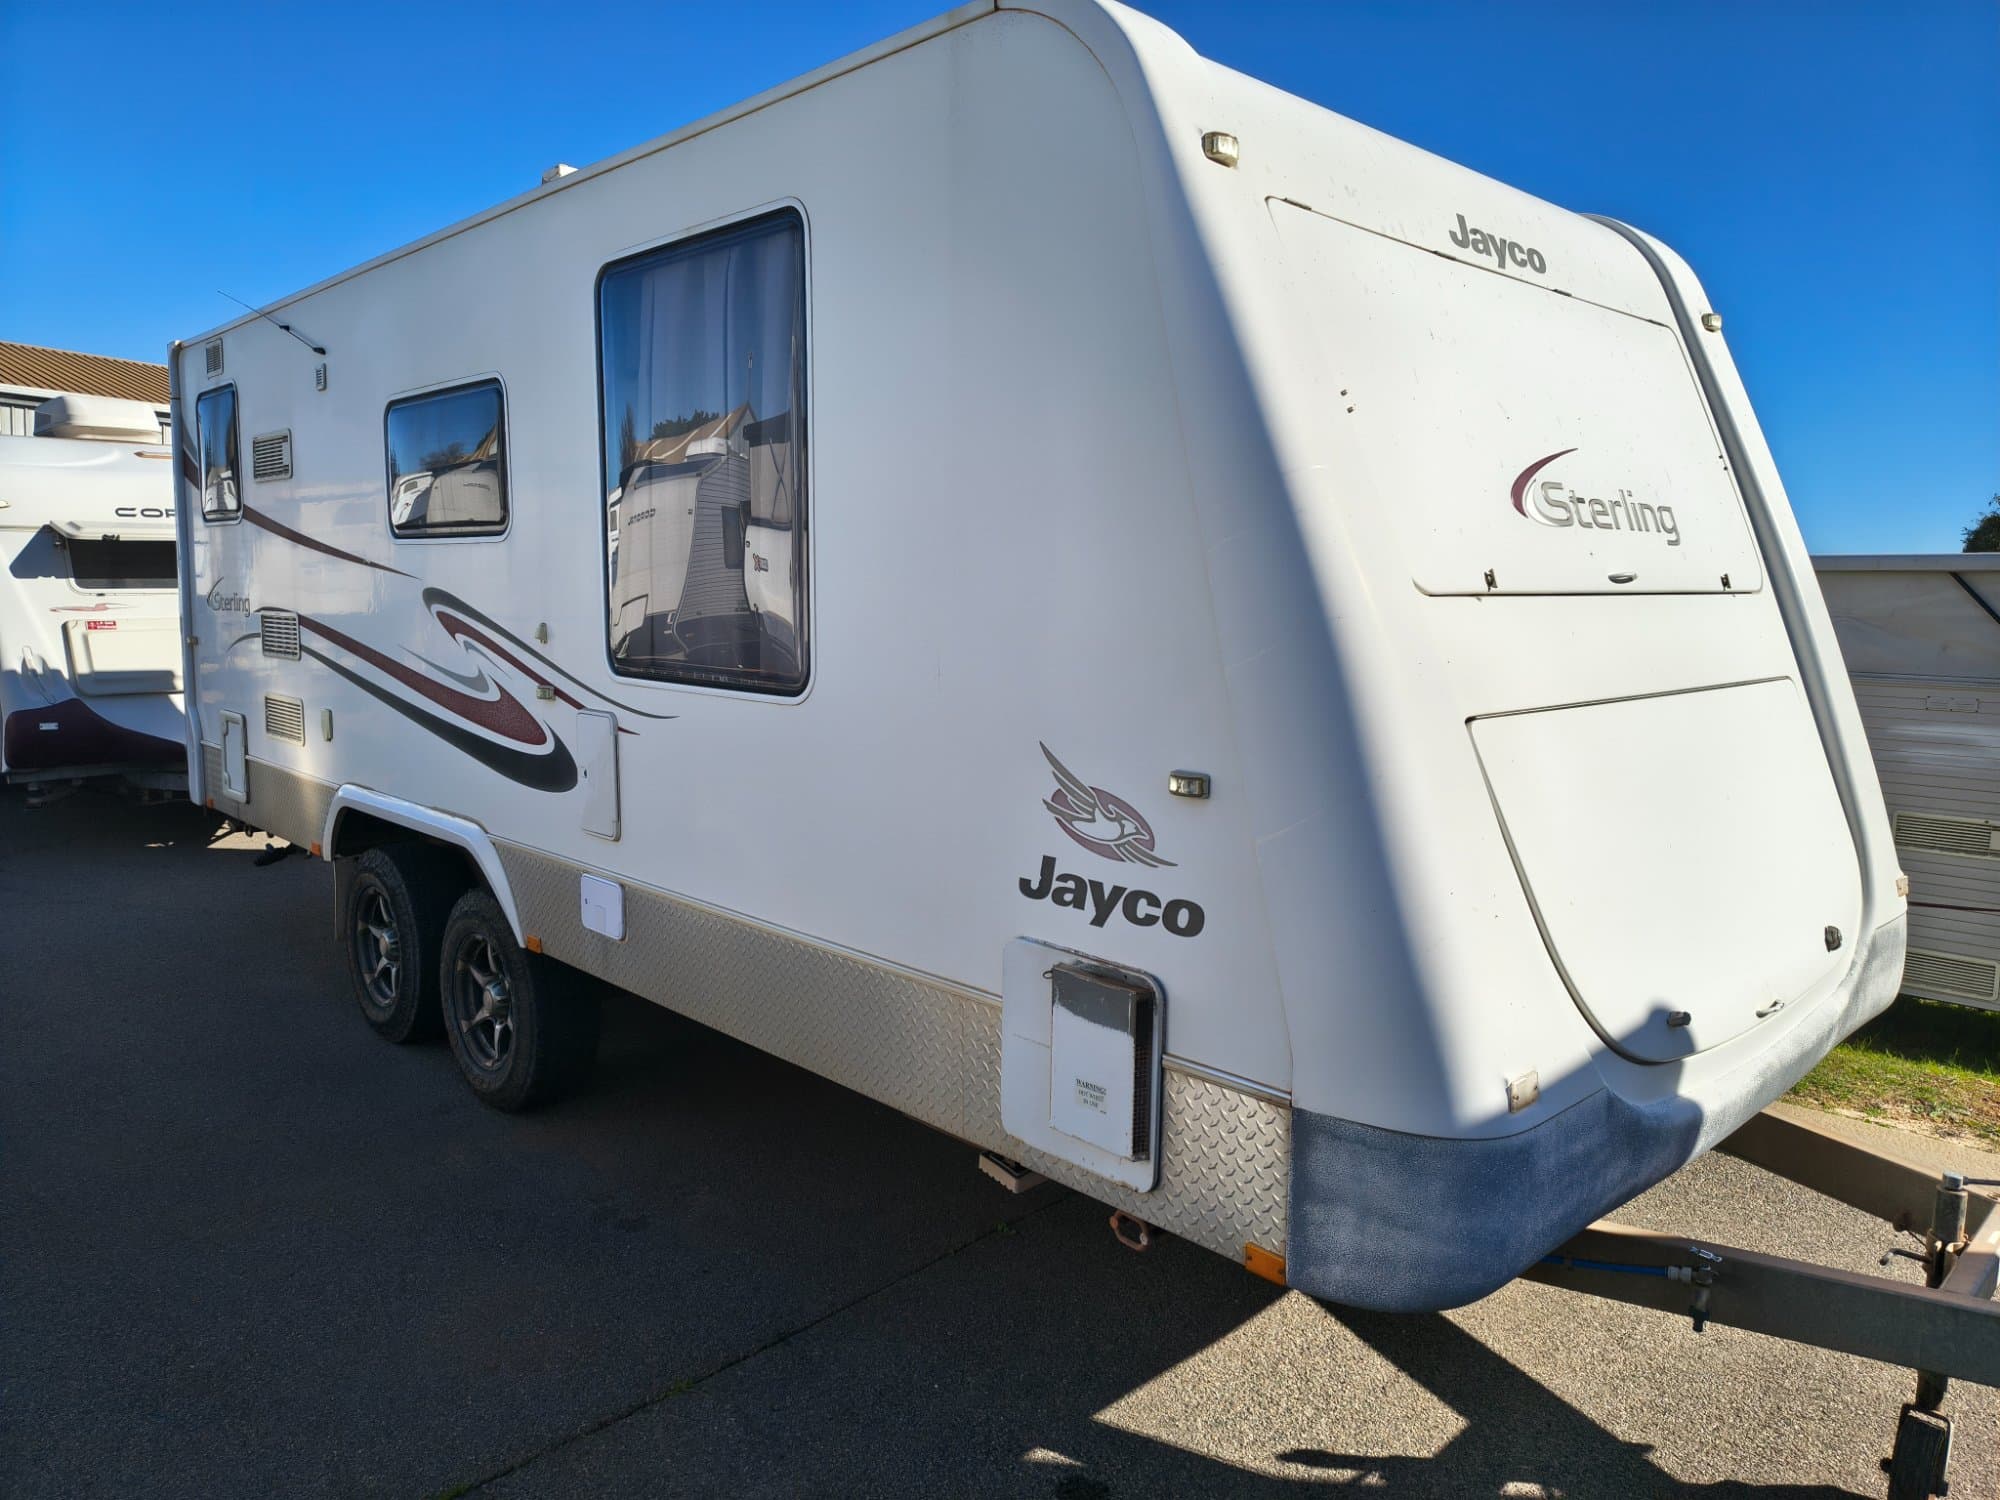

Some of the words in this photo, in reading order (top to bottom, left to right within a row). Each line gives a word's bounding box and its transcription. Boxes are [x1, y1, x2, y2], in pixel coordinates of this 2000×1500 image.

[1448, 213, 1547, 274] Jayco
[1540, 481, 1681, 546] Sterling
[1018, 855, 1205, 938] Jayco
